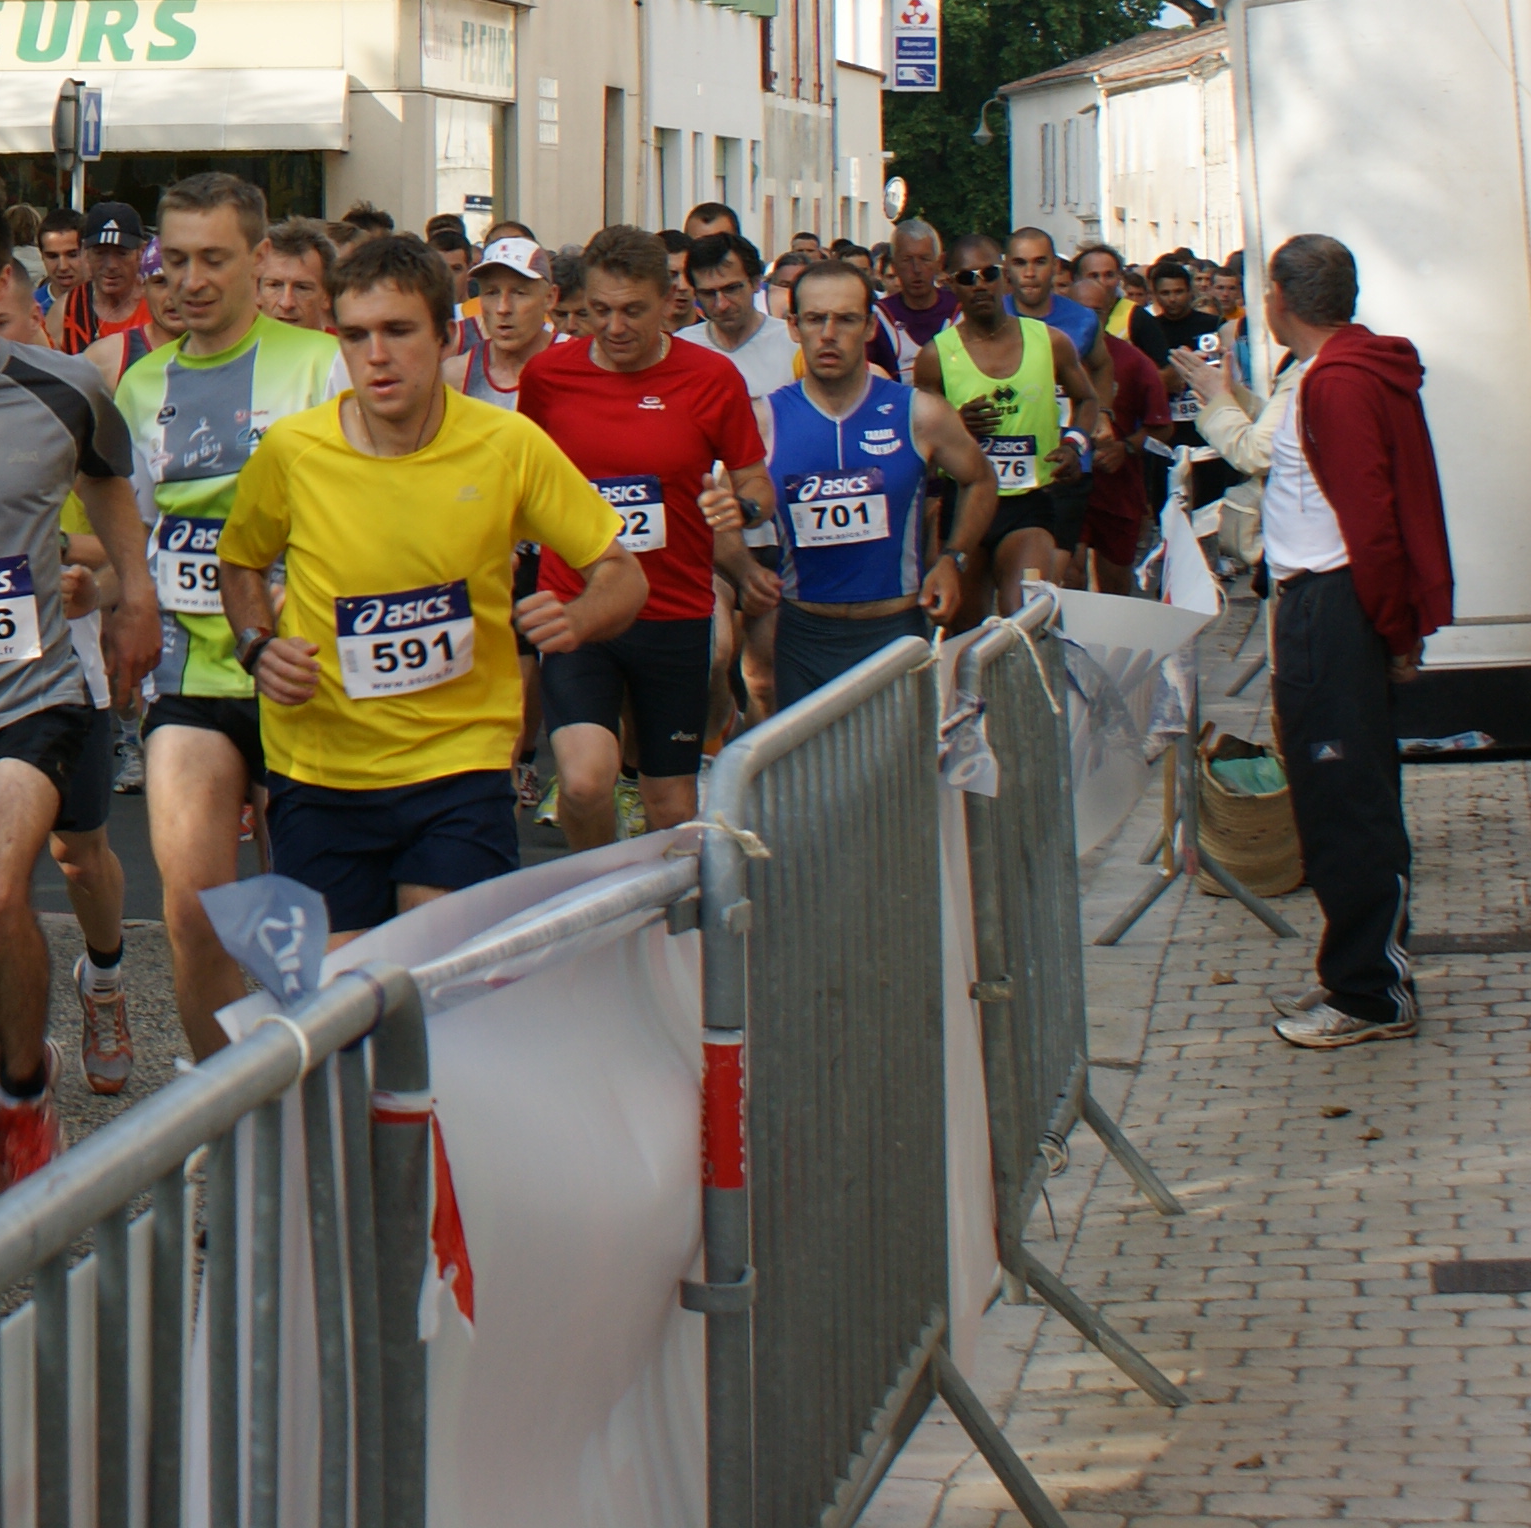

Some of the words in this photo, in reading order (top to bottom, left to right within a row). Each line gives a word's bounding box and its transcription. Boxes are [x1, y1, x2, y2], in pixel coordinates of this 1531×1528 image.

[820, 475, 869, 496] asics
[810, 501, 870, 530] 701
[384, 594, 451, 628] asics
[371, 630, 454, 673] 591
[370, 667, 454, 691] www.asics.fr
